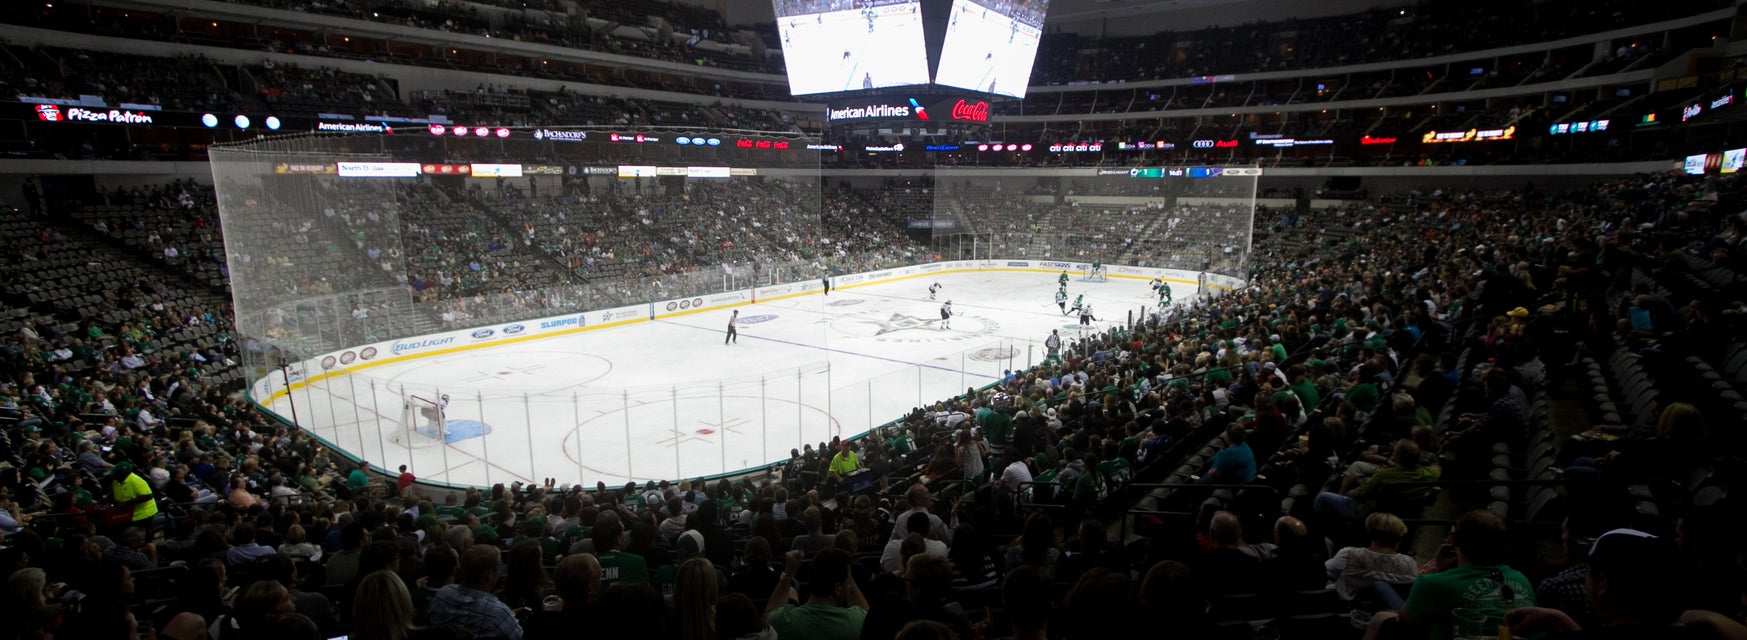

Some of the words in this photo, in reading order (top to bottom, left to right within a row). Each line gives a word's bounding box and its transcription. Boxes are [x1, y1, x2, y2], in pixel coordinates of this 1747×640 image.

[68, 108, 108, 121] Pizza
[831, 106, 865, 120] American
[865, 104, 909, 118] Airlines
[318, 122, 356, 131] American
[356, 123, 383, 132] Airlines
[1216, 139, 1238, 148] Audi
[395, 342, 421, 351] BUD
[422, 337, 456, 346] LIGHT
[600, 566, 619, 580] ENN
